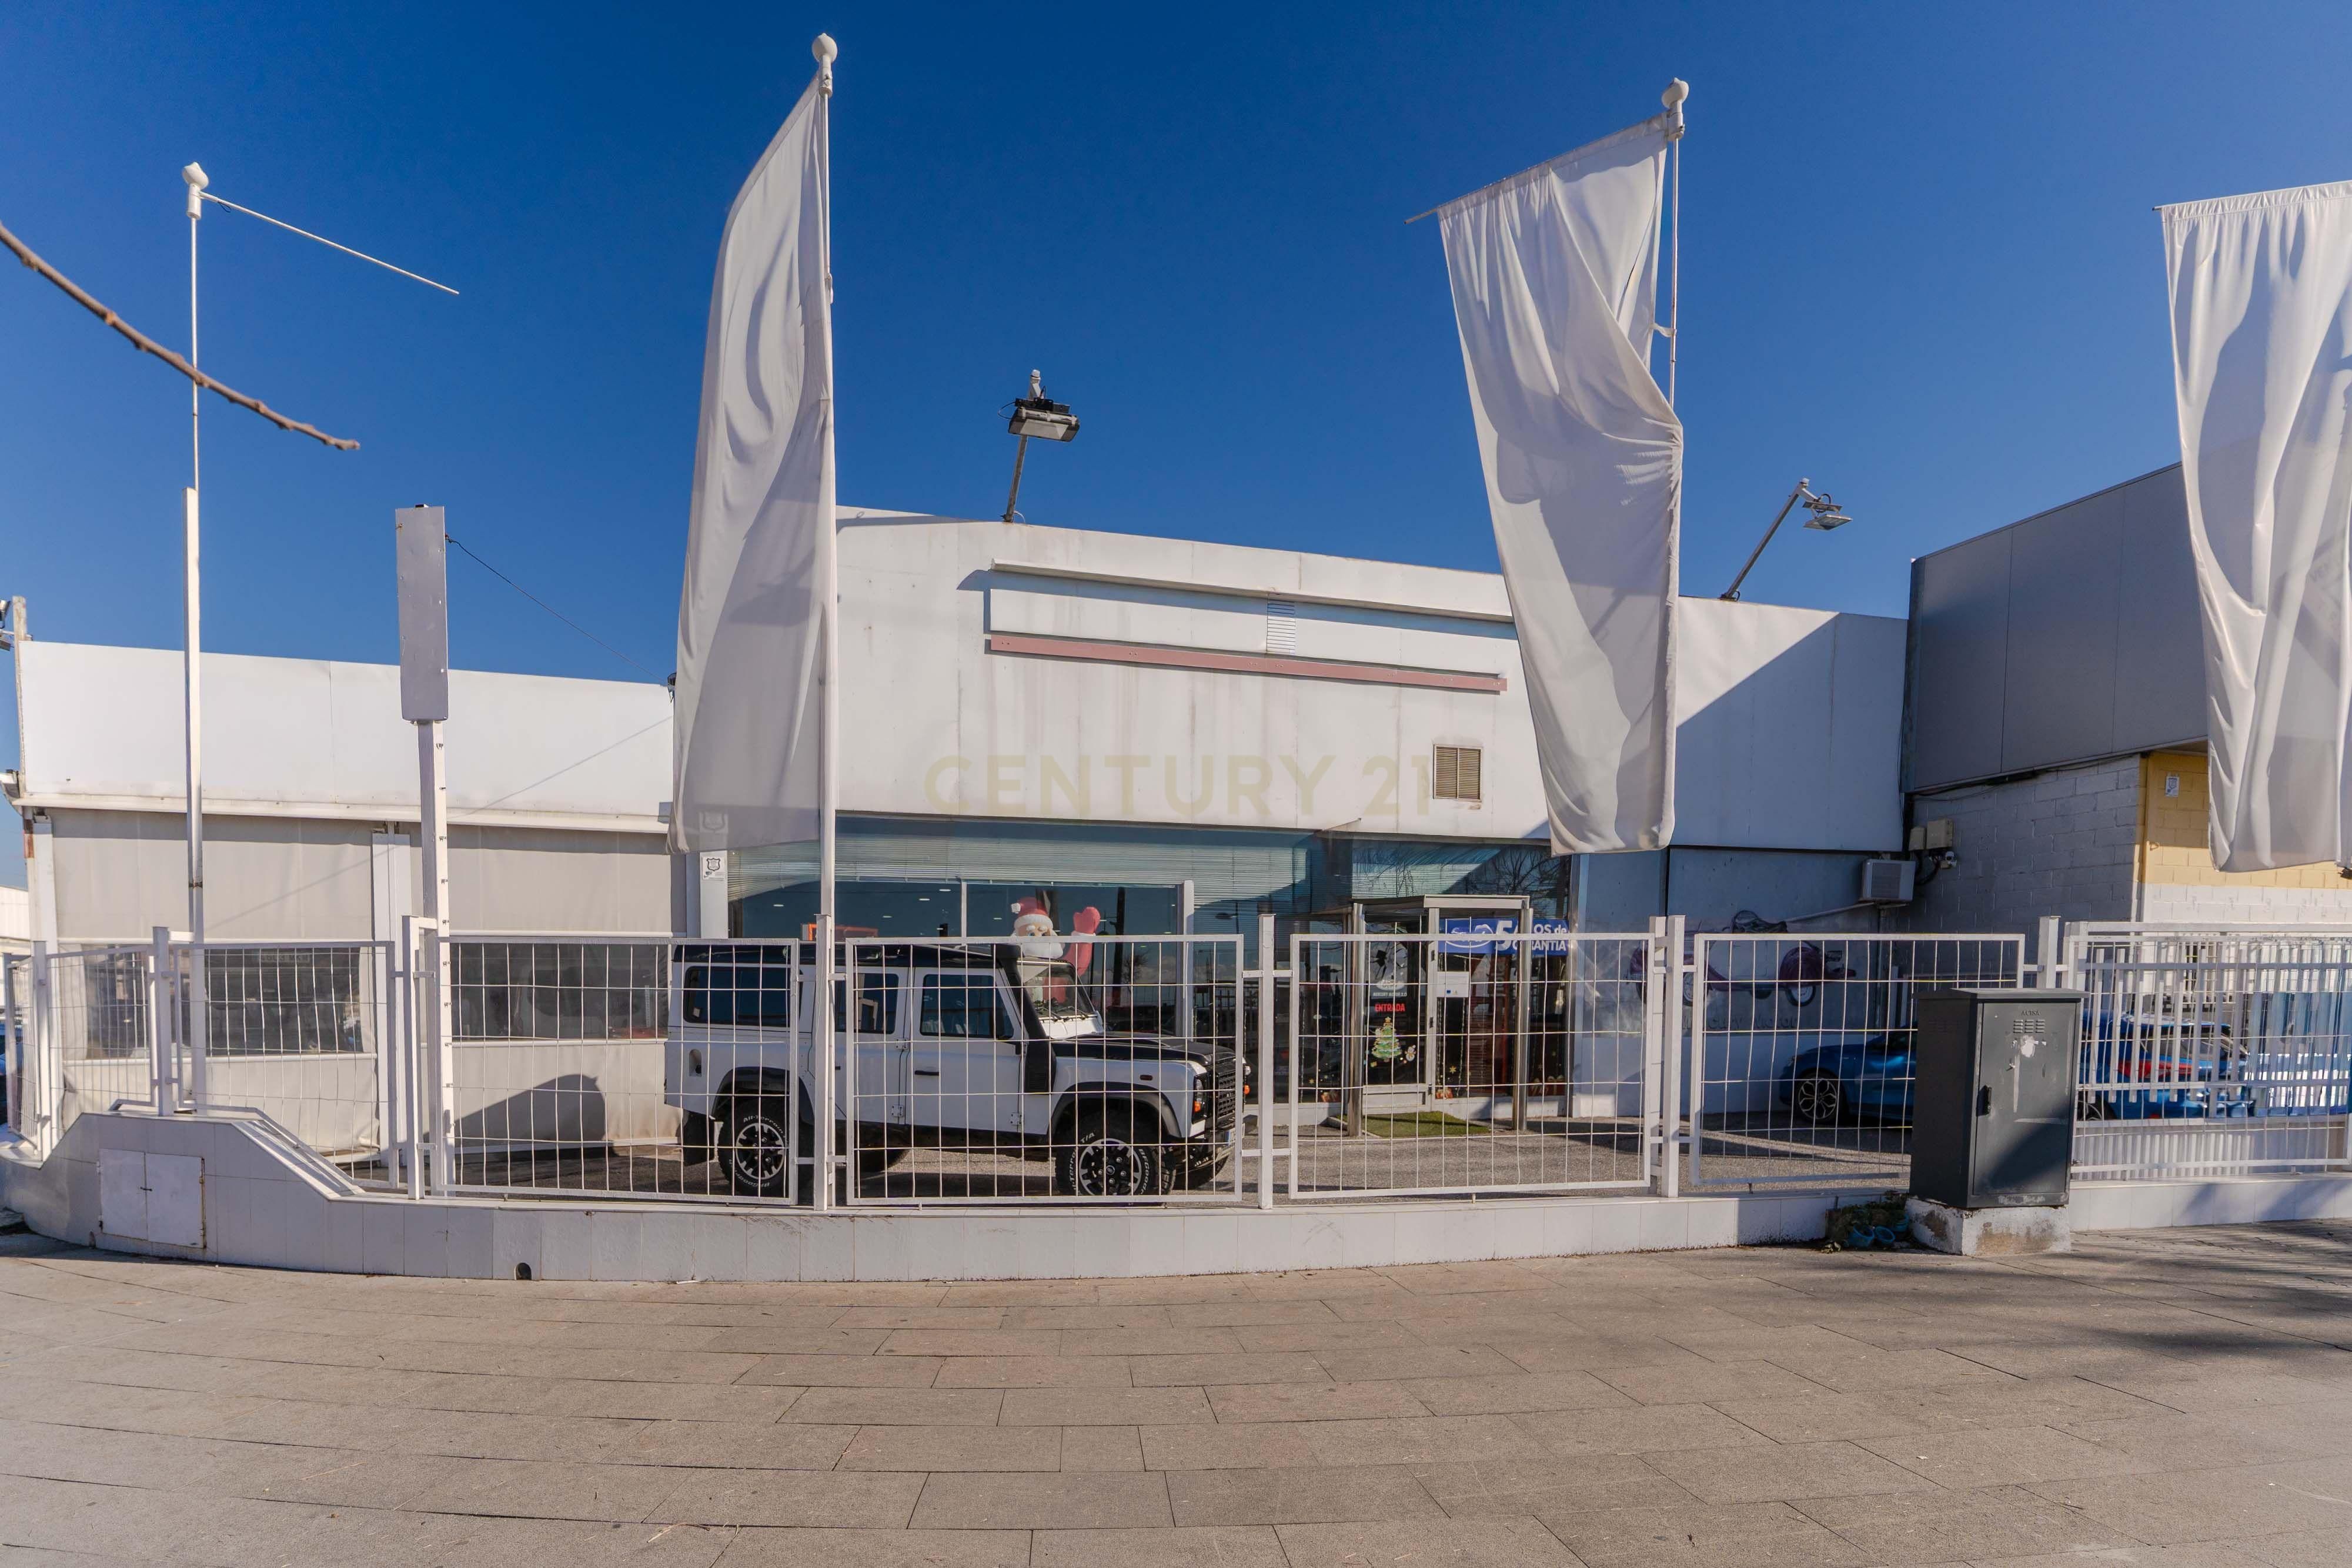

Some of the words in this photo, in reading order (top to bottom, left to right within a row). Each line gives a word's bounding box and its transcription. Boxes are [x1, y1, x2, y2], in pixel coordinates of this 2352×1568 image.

[1496, 920, 1512, 951] 5
[1554, 924, 1567, 934] de
[1375, 1003, 1405, 1012] ENTRADA
[1080, 1132, 1095, 1144] T/A
